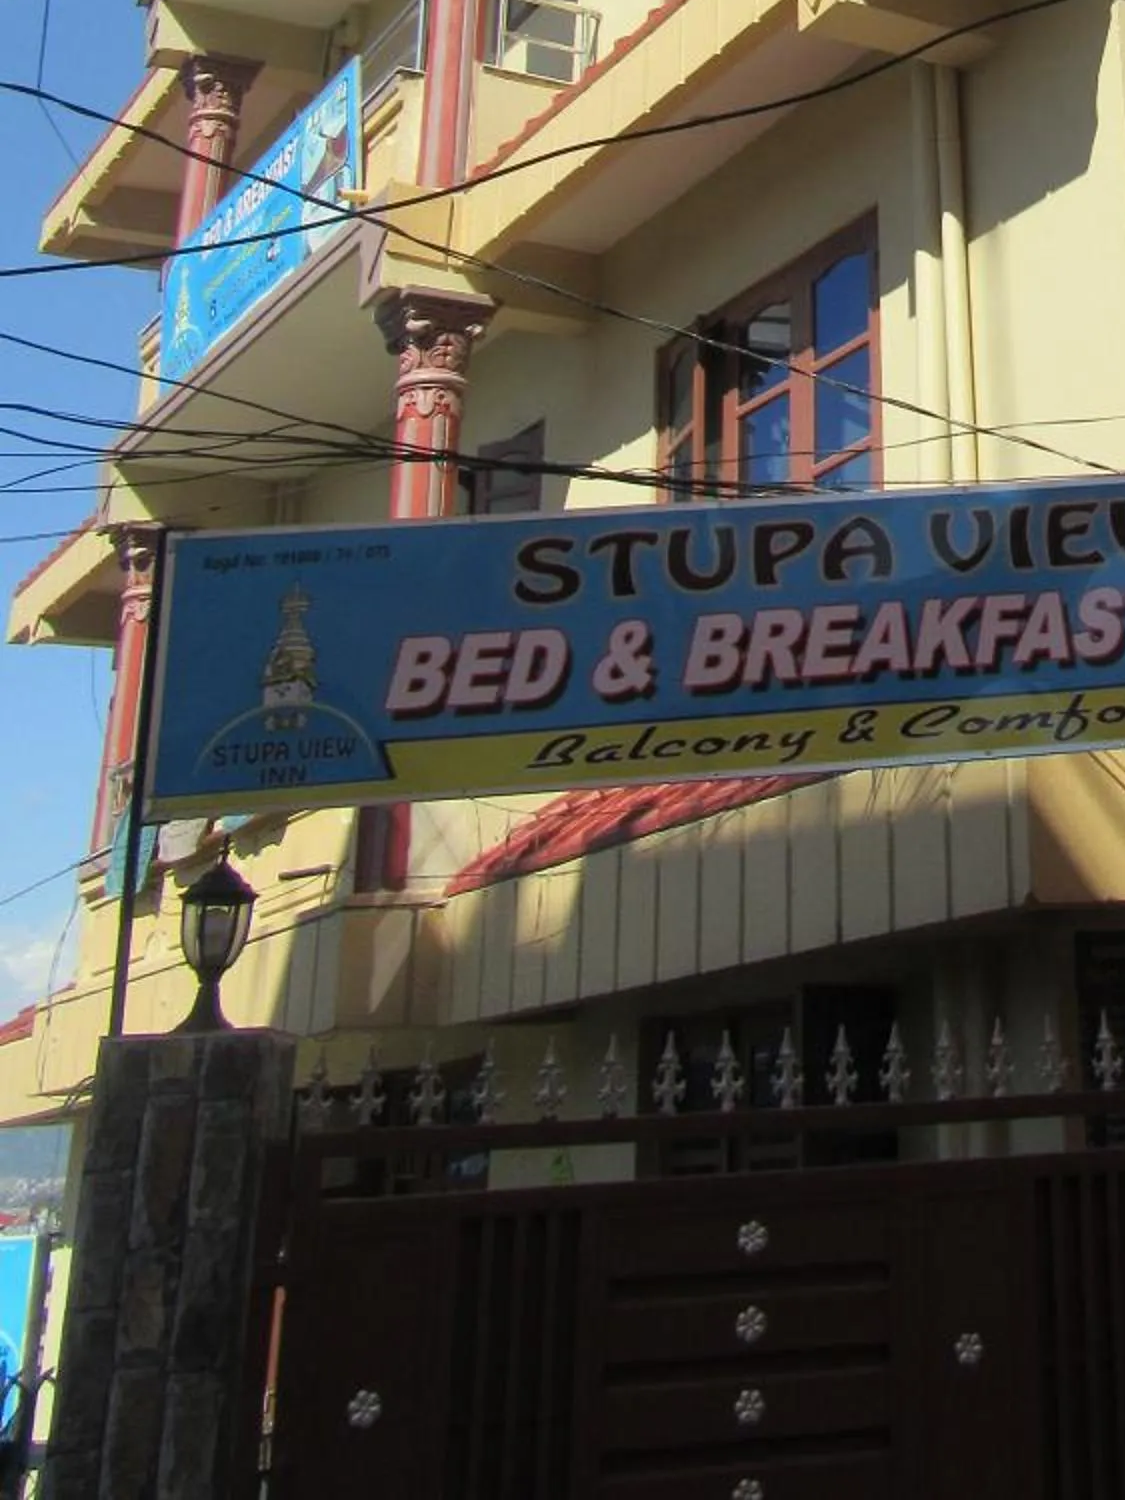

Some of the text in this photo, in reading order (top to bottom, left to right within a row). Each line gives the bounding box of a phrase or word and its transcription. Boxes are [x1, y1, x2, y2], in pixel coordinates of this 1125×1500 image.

[511, 515, 894, 605] STUPA
[384, 627, 572, 722] BED
[592, 619, 657, 705] &
[212, 740, 290, 767] STUPA
[527, 725, 817, 769] Balcony
[838, 709, 879, 743] &
[260, 765, 308, 785] INN
